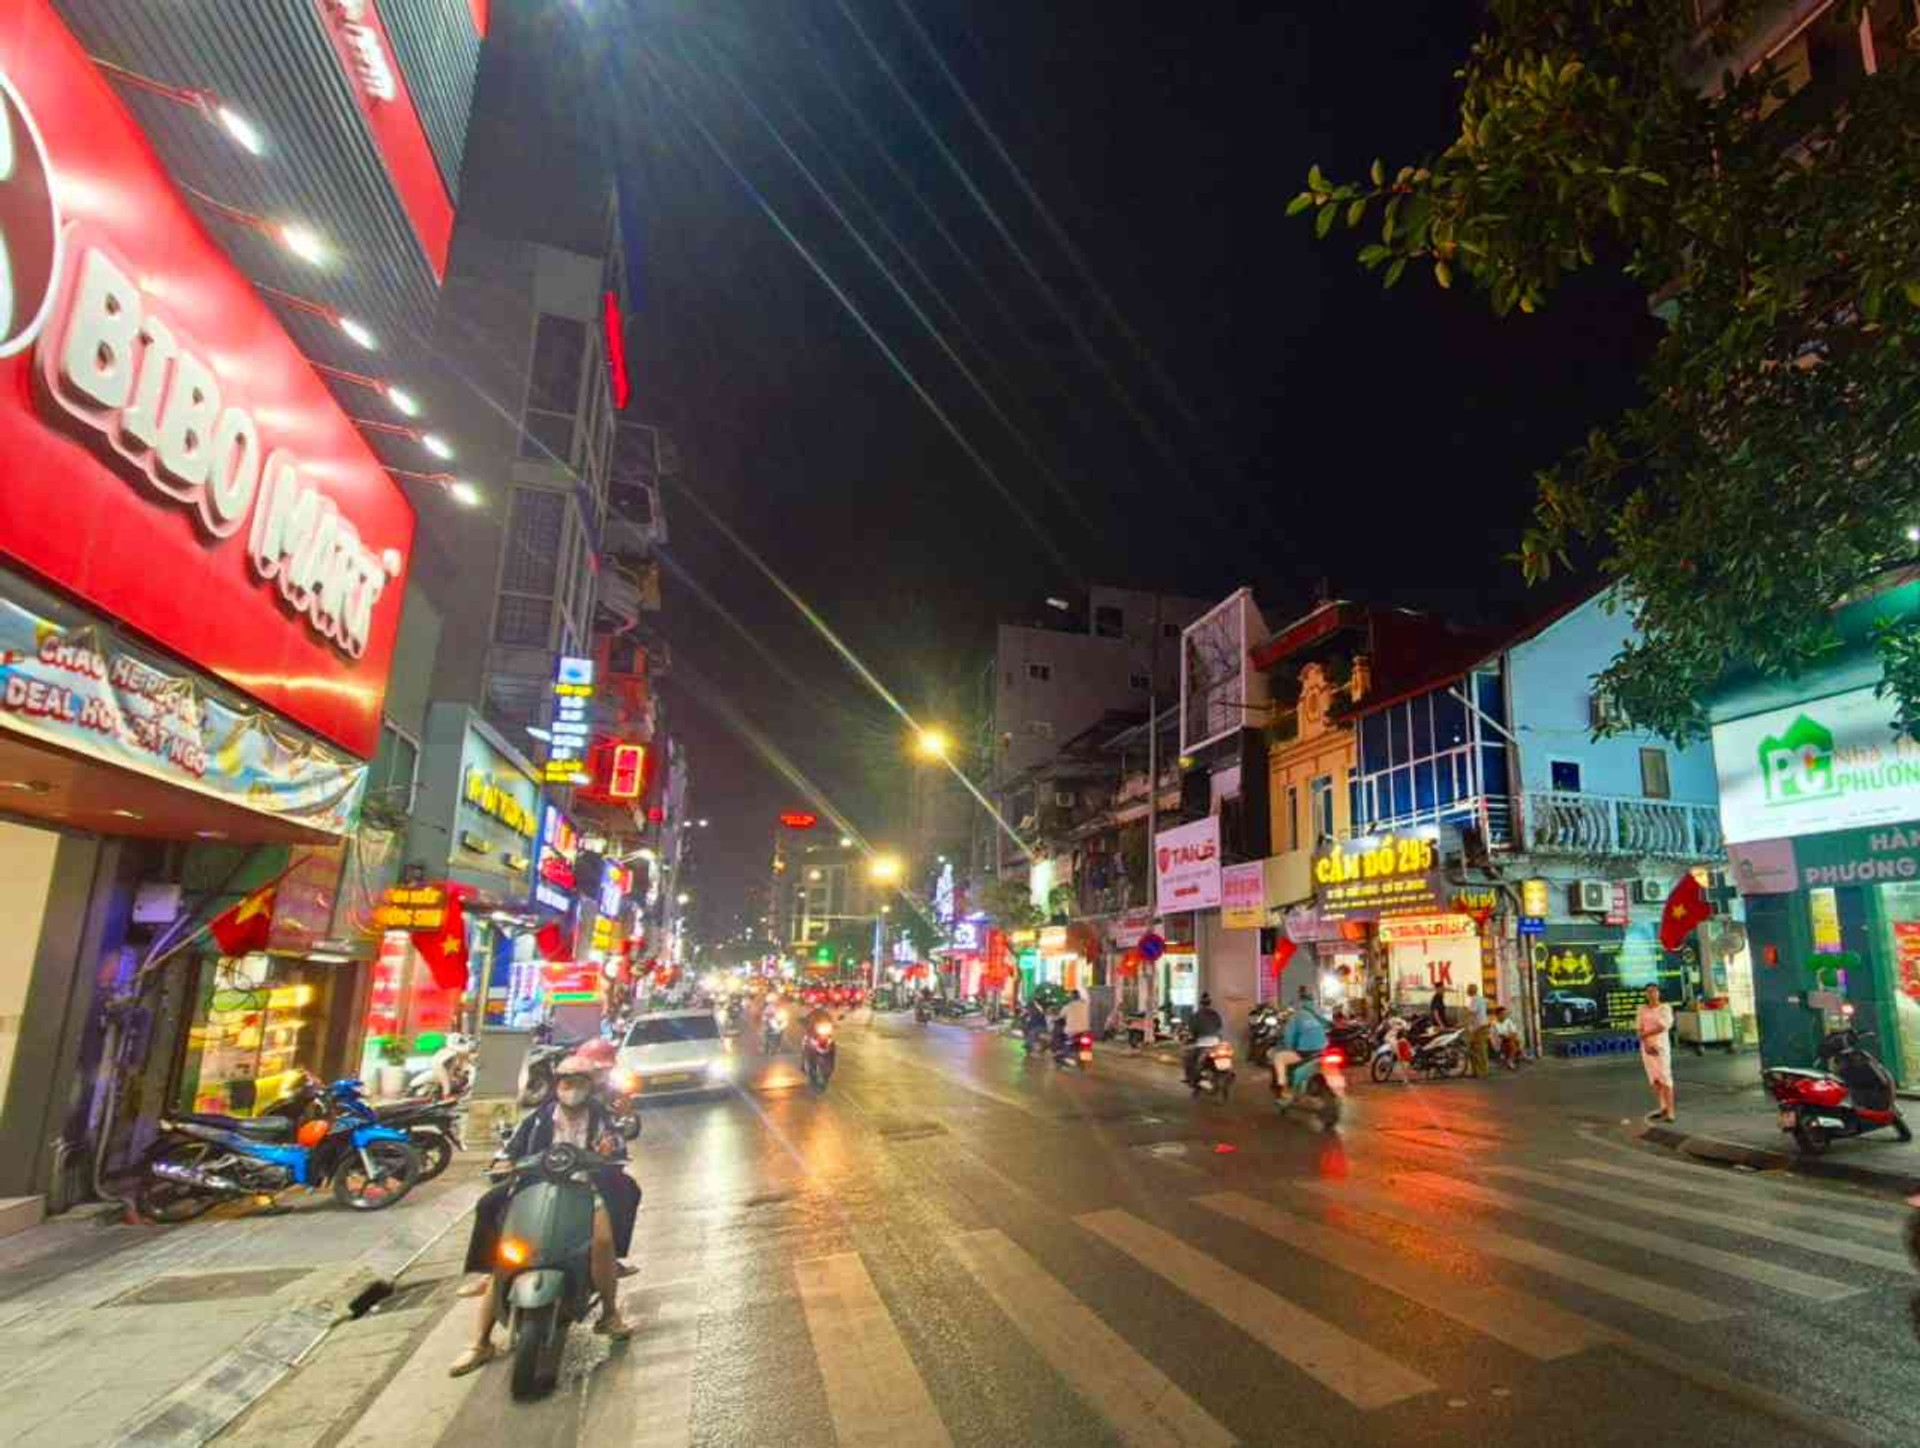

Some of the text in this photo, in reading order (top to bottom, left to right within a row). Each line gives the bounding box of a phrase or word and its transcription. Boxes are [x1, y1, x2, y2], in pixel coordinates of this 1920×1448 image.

[62, 246, 259, 526] BIBO
[252, 452, 387, 654] MART
[6, 675, 76, 724] DEAL
[1398, 839, 1433, 873] 295
